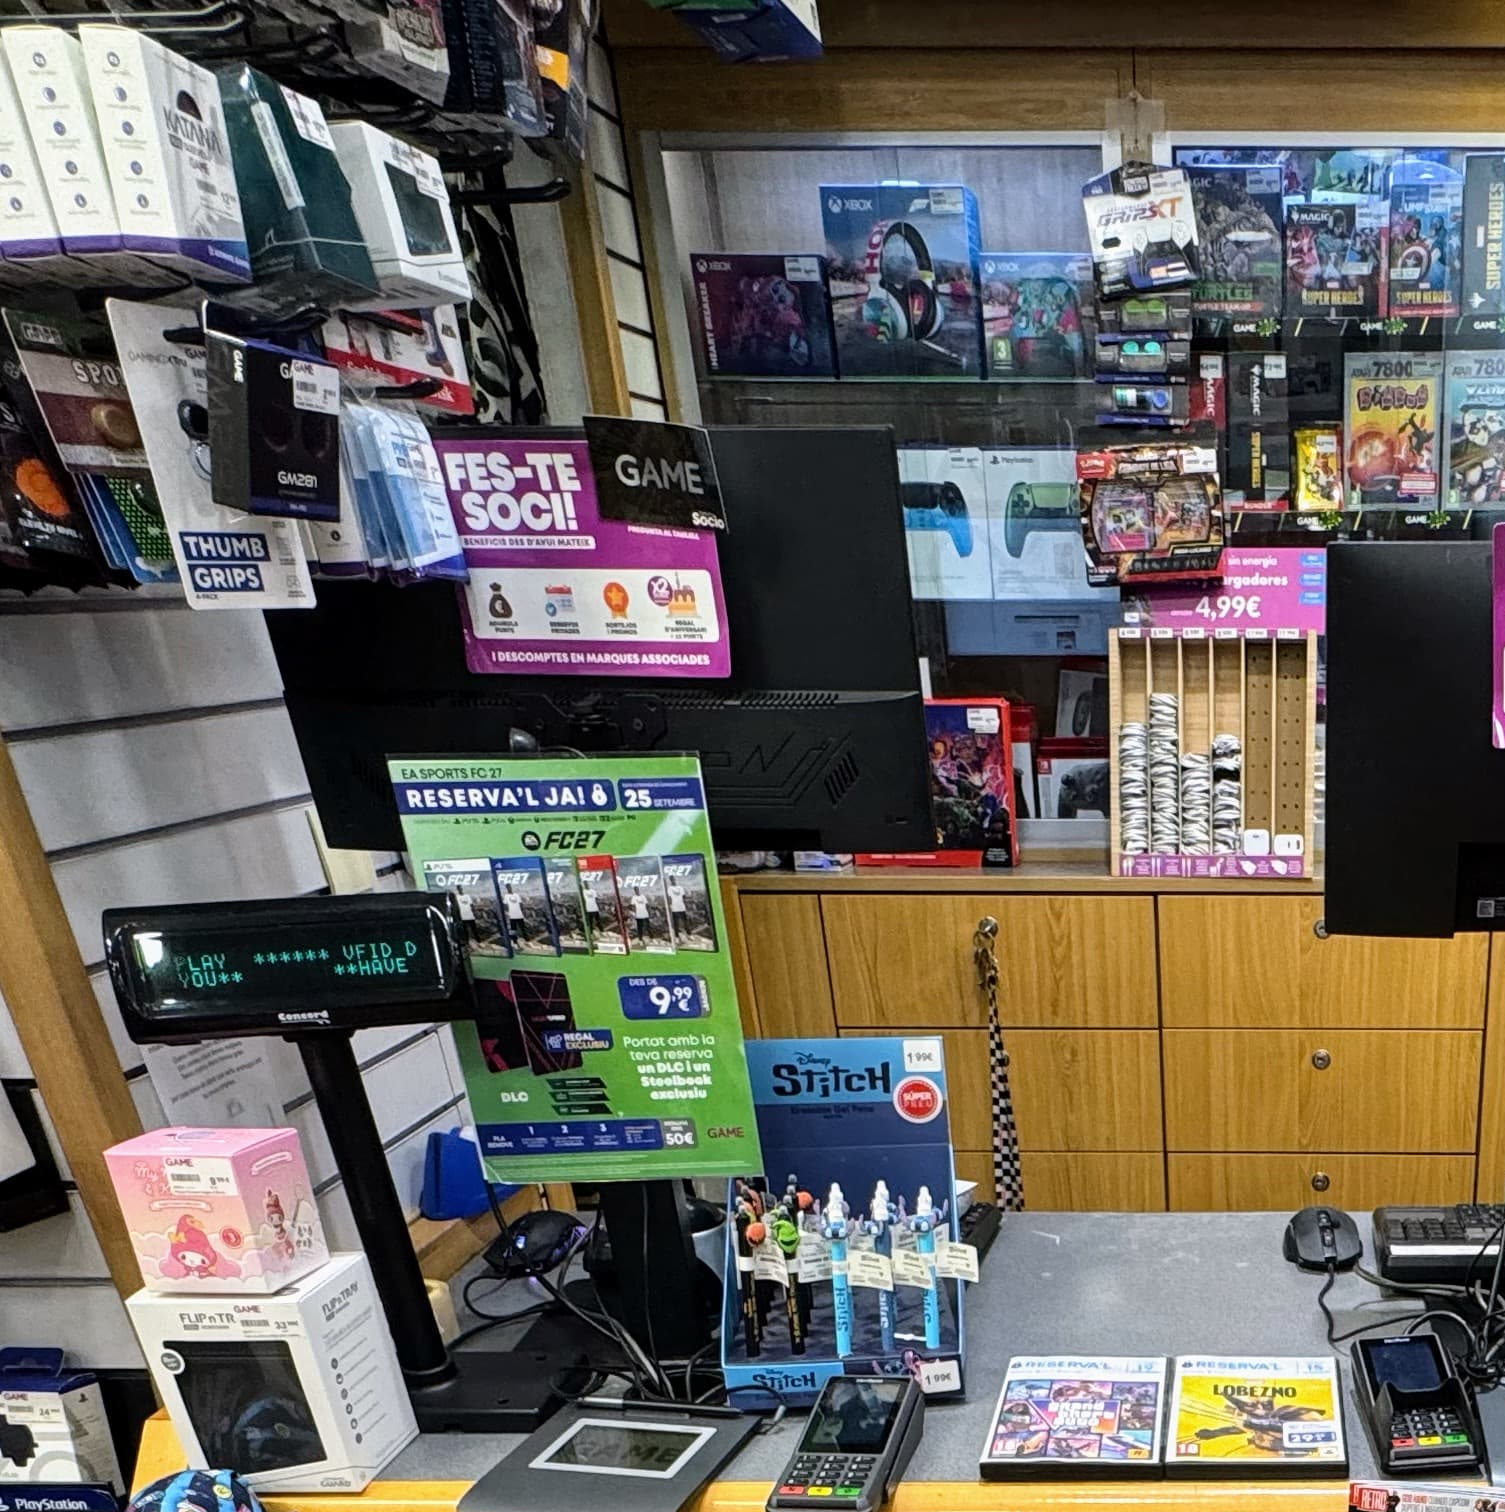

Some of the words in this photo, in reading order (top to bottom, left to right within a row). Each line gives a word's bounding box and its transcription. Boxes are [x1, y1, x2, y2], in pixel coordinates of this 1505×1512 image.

[615, 455, 704, 494] GAME
[183, 536, 265, 558] THUMB
[1243, 555, 1278, 568] energía
[194, 567, 260, 591] GRIPS
[1195, 596, 1261, 619] 4,99€
[402, 768, 418, 779] EA
[419, 768, 469, 779] SPORTS
[471, 768, 487, 779] FC
[489, 768, 502, 778] 27
[406, 787, 545, 808] RESERVA'L
[544, 787, 585, 804] JA!
[624, 789, 651, 808] 25
[544, 831, 606, 850] FC27
[342, 943, 392, 961] VFID
[623, 1036, 665, 1048] Portat
[667, 1036, 700, 1046] amb
[629, 1051, 660, 1060] teva
[663, 1050, 713, 1059] reserva
[637, 1065, 656, 1073] un
[657, 1063, 685, 1073] DLC
[708, 1127, 744, 1139] GAME
[166, 1158, 193, 1168] GAME
[1213, 1385, 1297, 1398] LOBEZNO
[15, 1499, 88, 1511] PlayStation
[1361, 1490, 1387, 1511] RETRO
